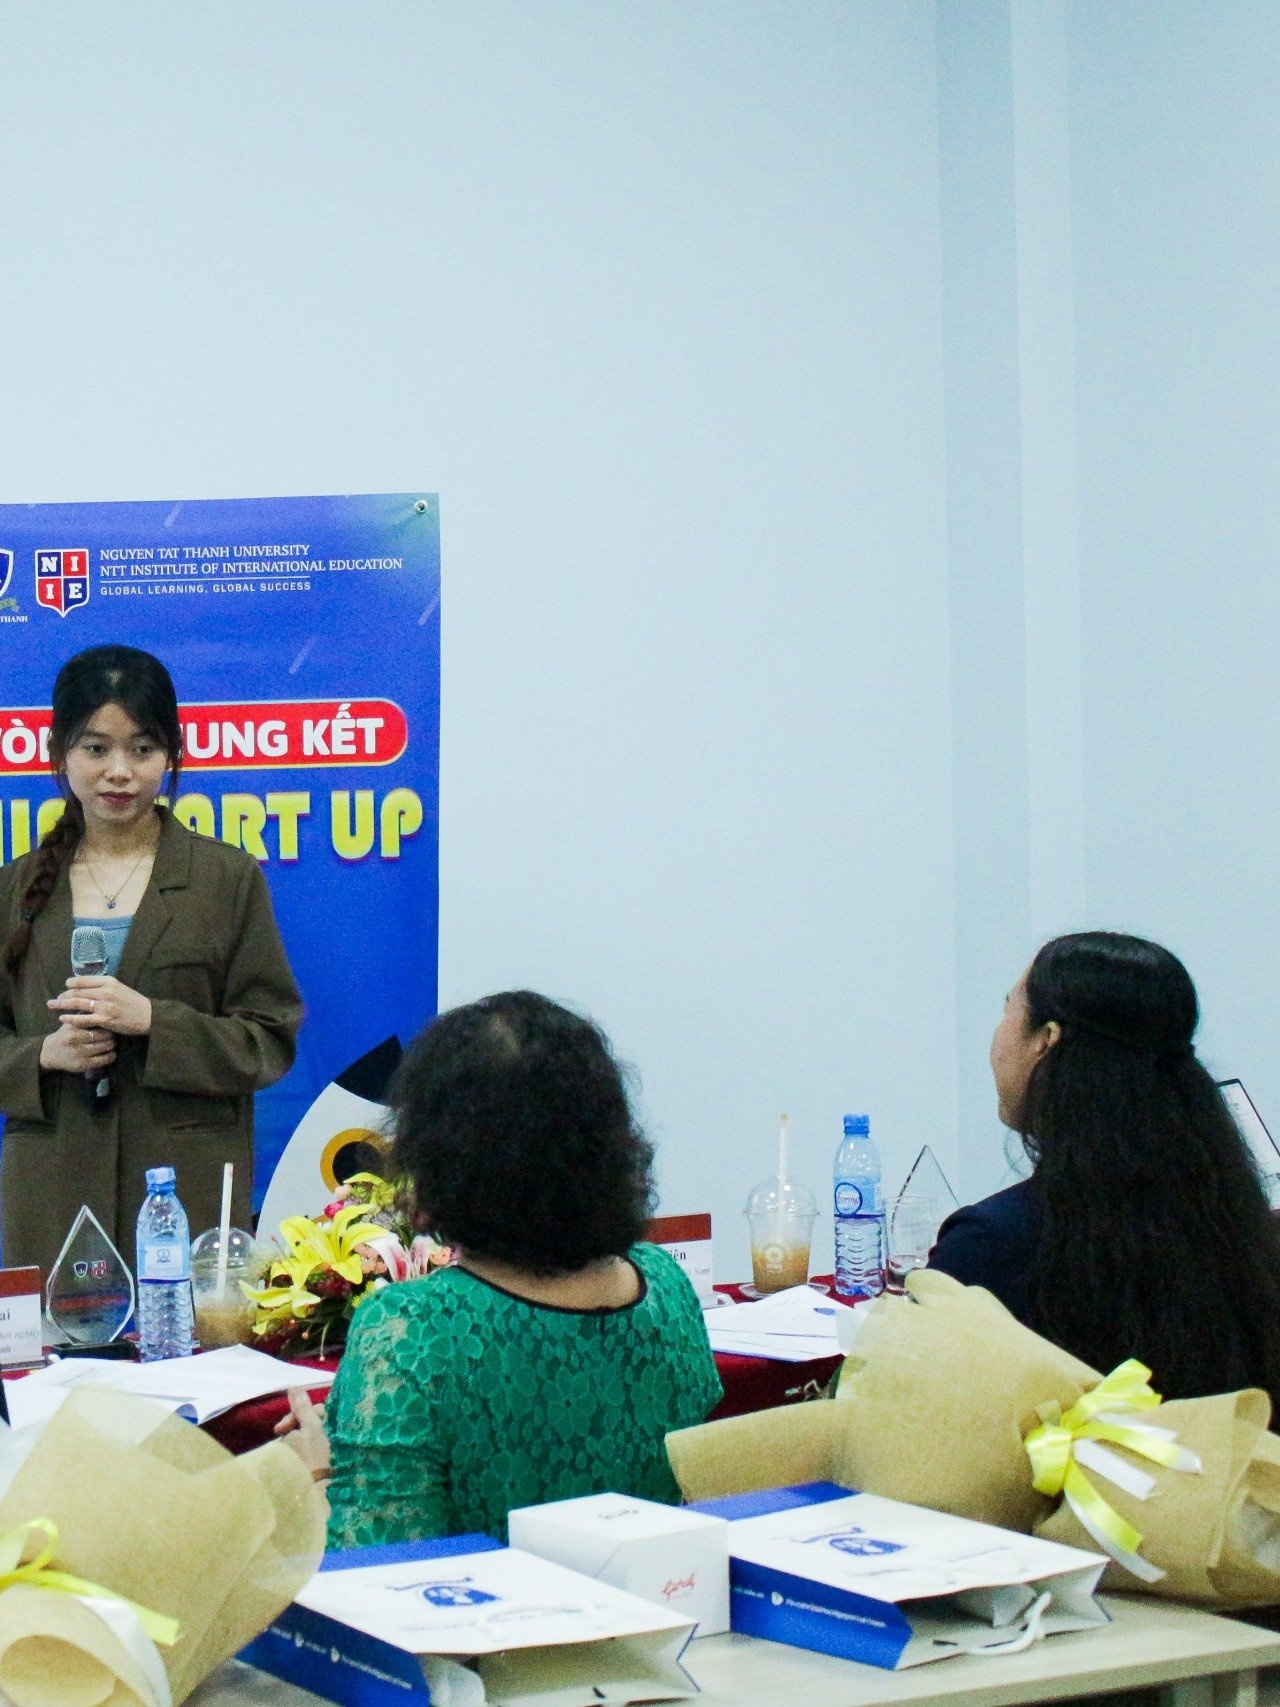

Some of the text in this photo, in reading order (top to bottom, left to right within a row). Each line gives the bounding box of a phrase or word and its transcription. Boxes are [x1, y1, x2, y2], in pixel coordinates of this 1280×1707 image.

[100, 544, 310, 561] NGUYEN TAT THANH UNIVERSITY
[100, 558, 404, 577] NTT INSTITUTE OF INTERNATIONAL EDUCATION
[100, 582, 311, 596] GLOBAL LEARNING, GLOBAL SUCCESS
[0, 615, 29, 623] THANH
[180, 720, 289, 759] UNG
[302, 703, 384, 756] KẾT
[158, 791, 311, 862] ART
[331, 787, 423, 861] UP
